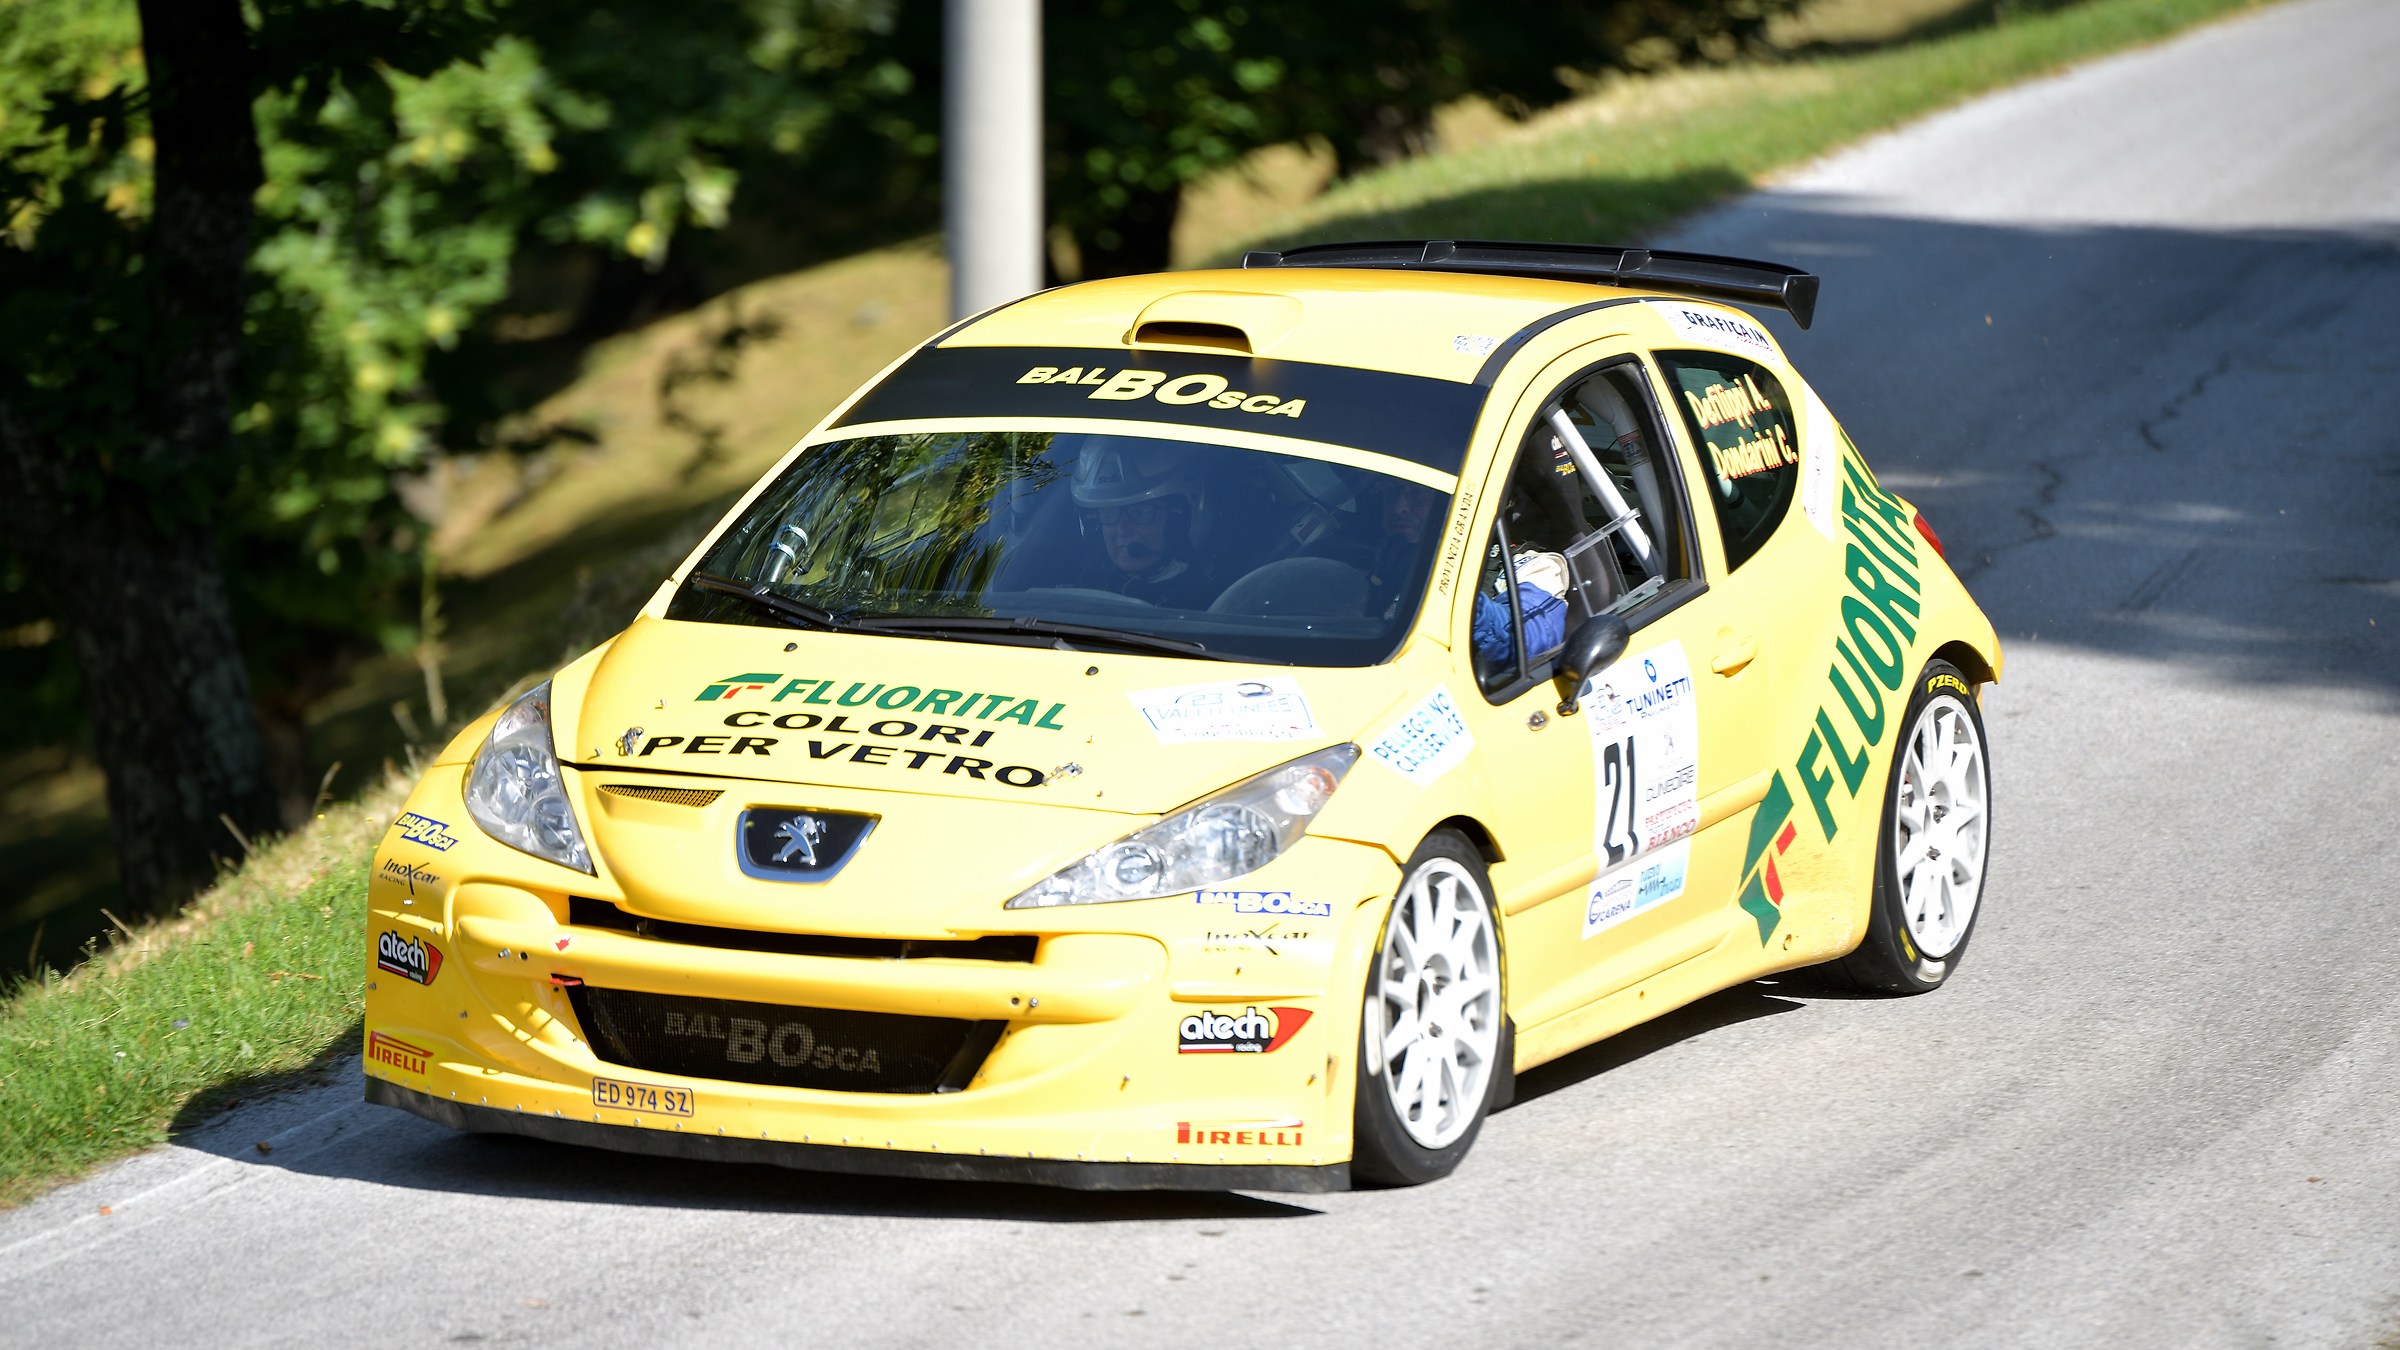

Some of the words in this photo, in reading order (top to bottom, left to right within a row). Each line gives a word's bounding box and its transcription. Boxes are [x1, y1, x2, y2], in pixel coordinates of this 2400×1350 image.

[1775, 423, 1799, 464] C.
[771, 678, 1067, 731] FLUORITAL
[1626, 676, 1691, 715] TUNINETTI
[723, 711, 995, 748] COLORI
[1374, 692, 1450, 760] PELLEGRINO
[638, 735, 779, 757] PER
[807, 740, 1046, 788] VETRO
[1603, 735, 1639, 868] 21
[380, 931, 426, 971] atech
[1179, 1006, 1269, 1040] atech
[369, 1029, 435, 1076] PIRELLI
[597, 1082, 621, 1104] ED
[626, 1086, 657, 1111] 974
[665, 1090, 690, 1113] SZ
[1177, 1119, 1304, 1146] PIRELLI
